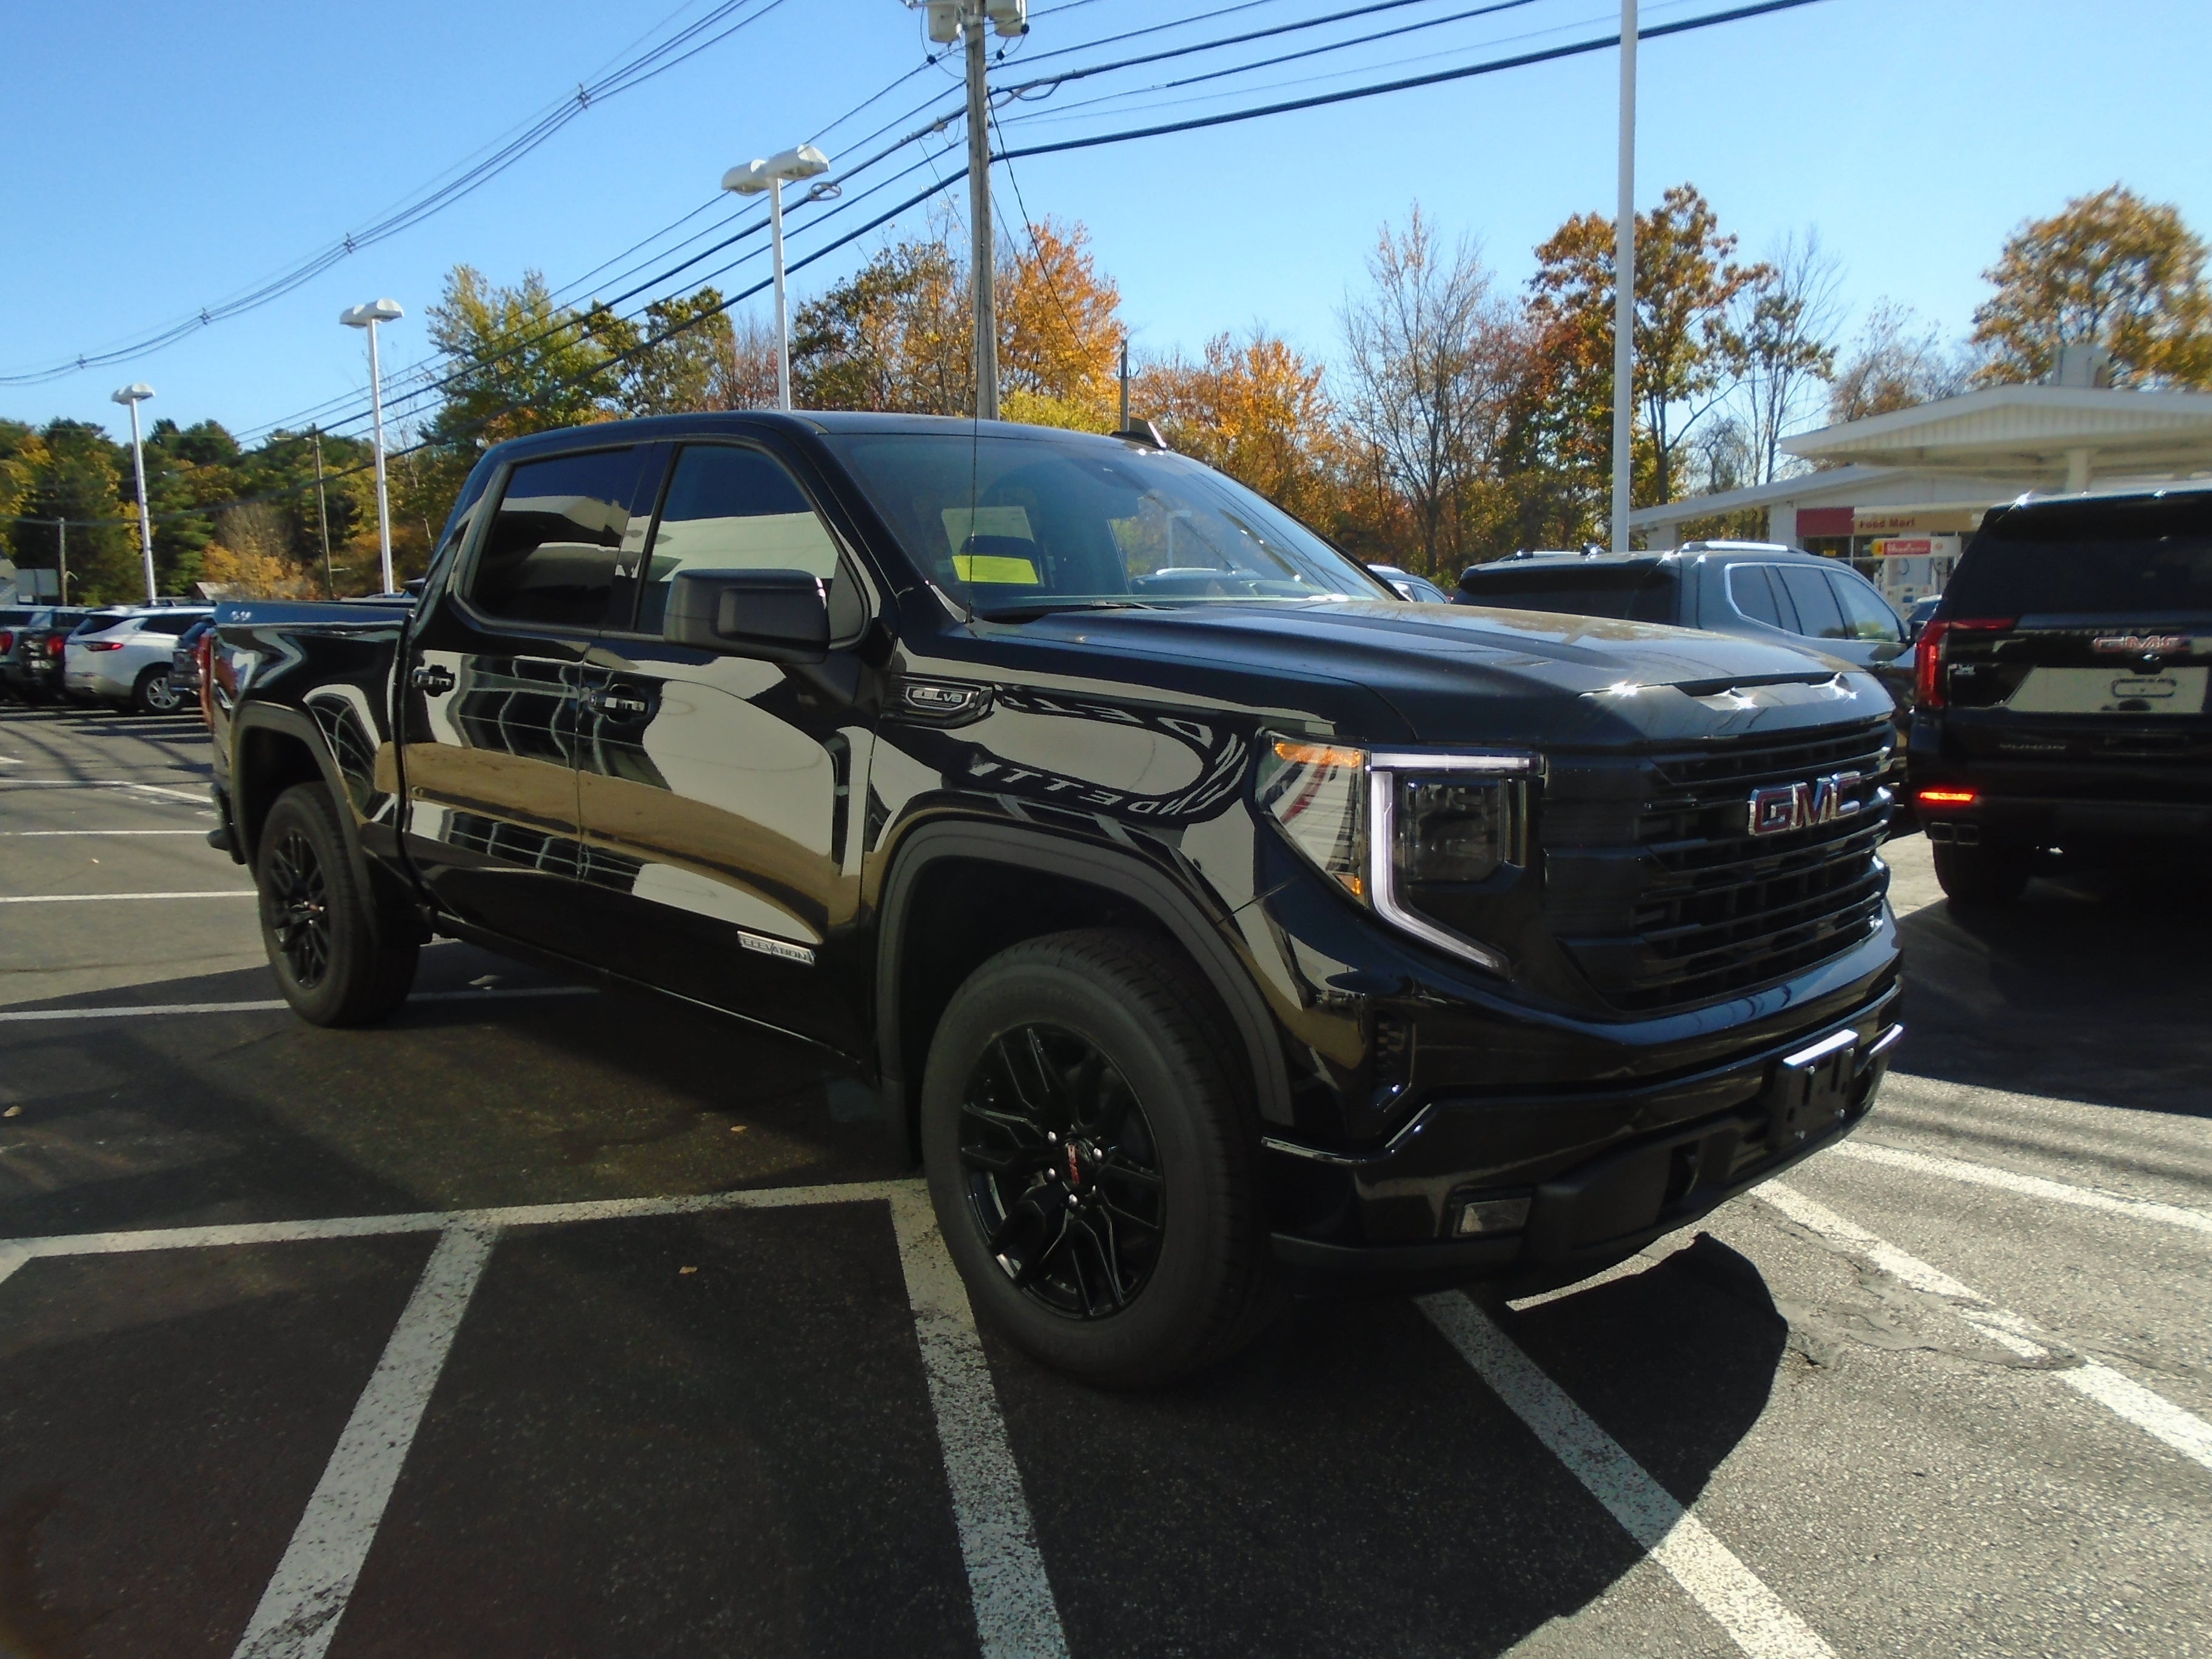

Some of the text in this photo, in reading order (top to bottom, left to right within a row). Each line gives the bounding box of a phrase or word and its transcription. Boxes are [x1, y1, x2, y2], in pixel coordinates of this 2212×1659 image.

[1859, 518, 1916, 529] Food Mart
[2093, 635, 2190, 653] GMC
[1747, 771, 1861, 836] GMC
[743, 938, 808, 960] ELEVATION
